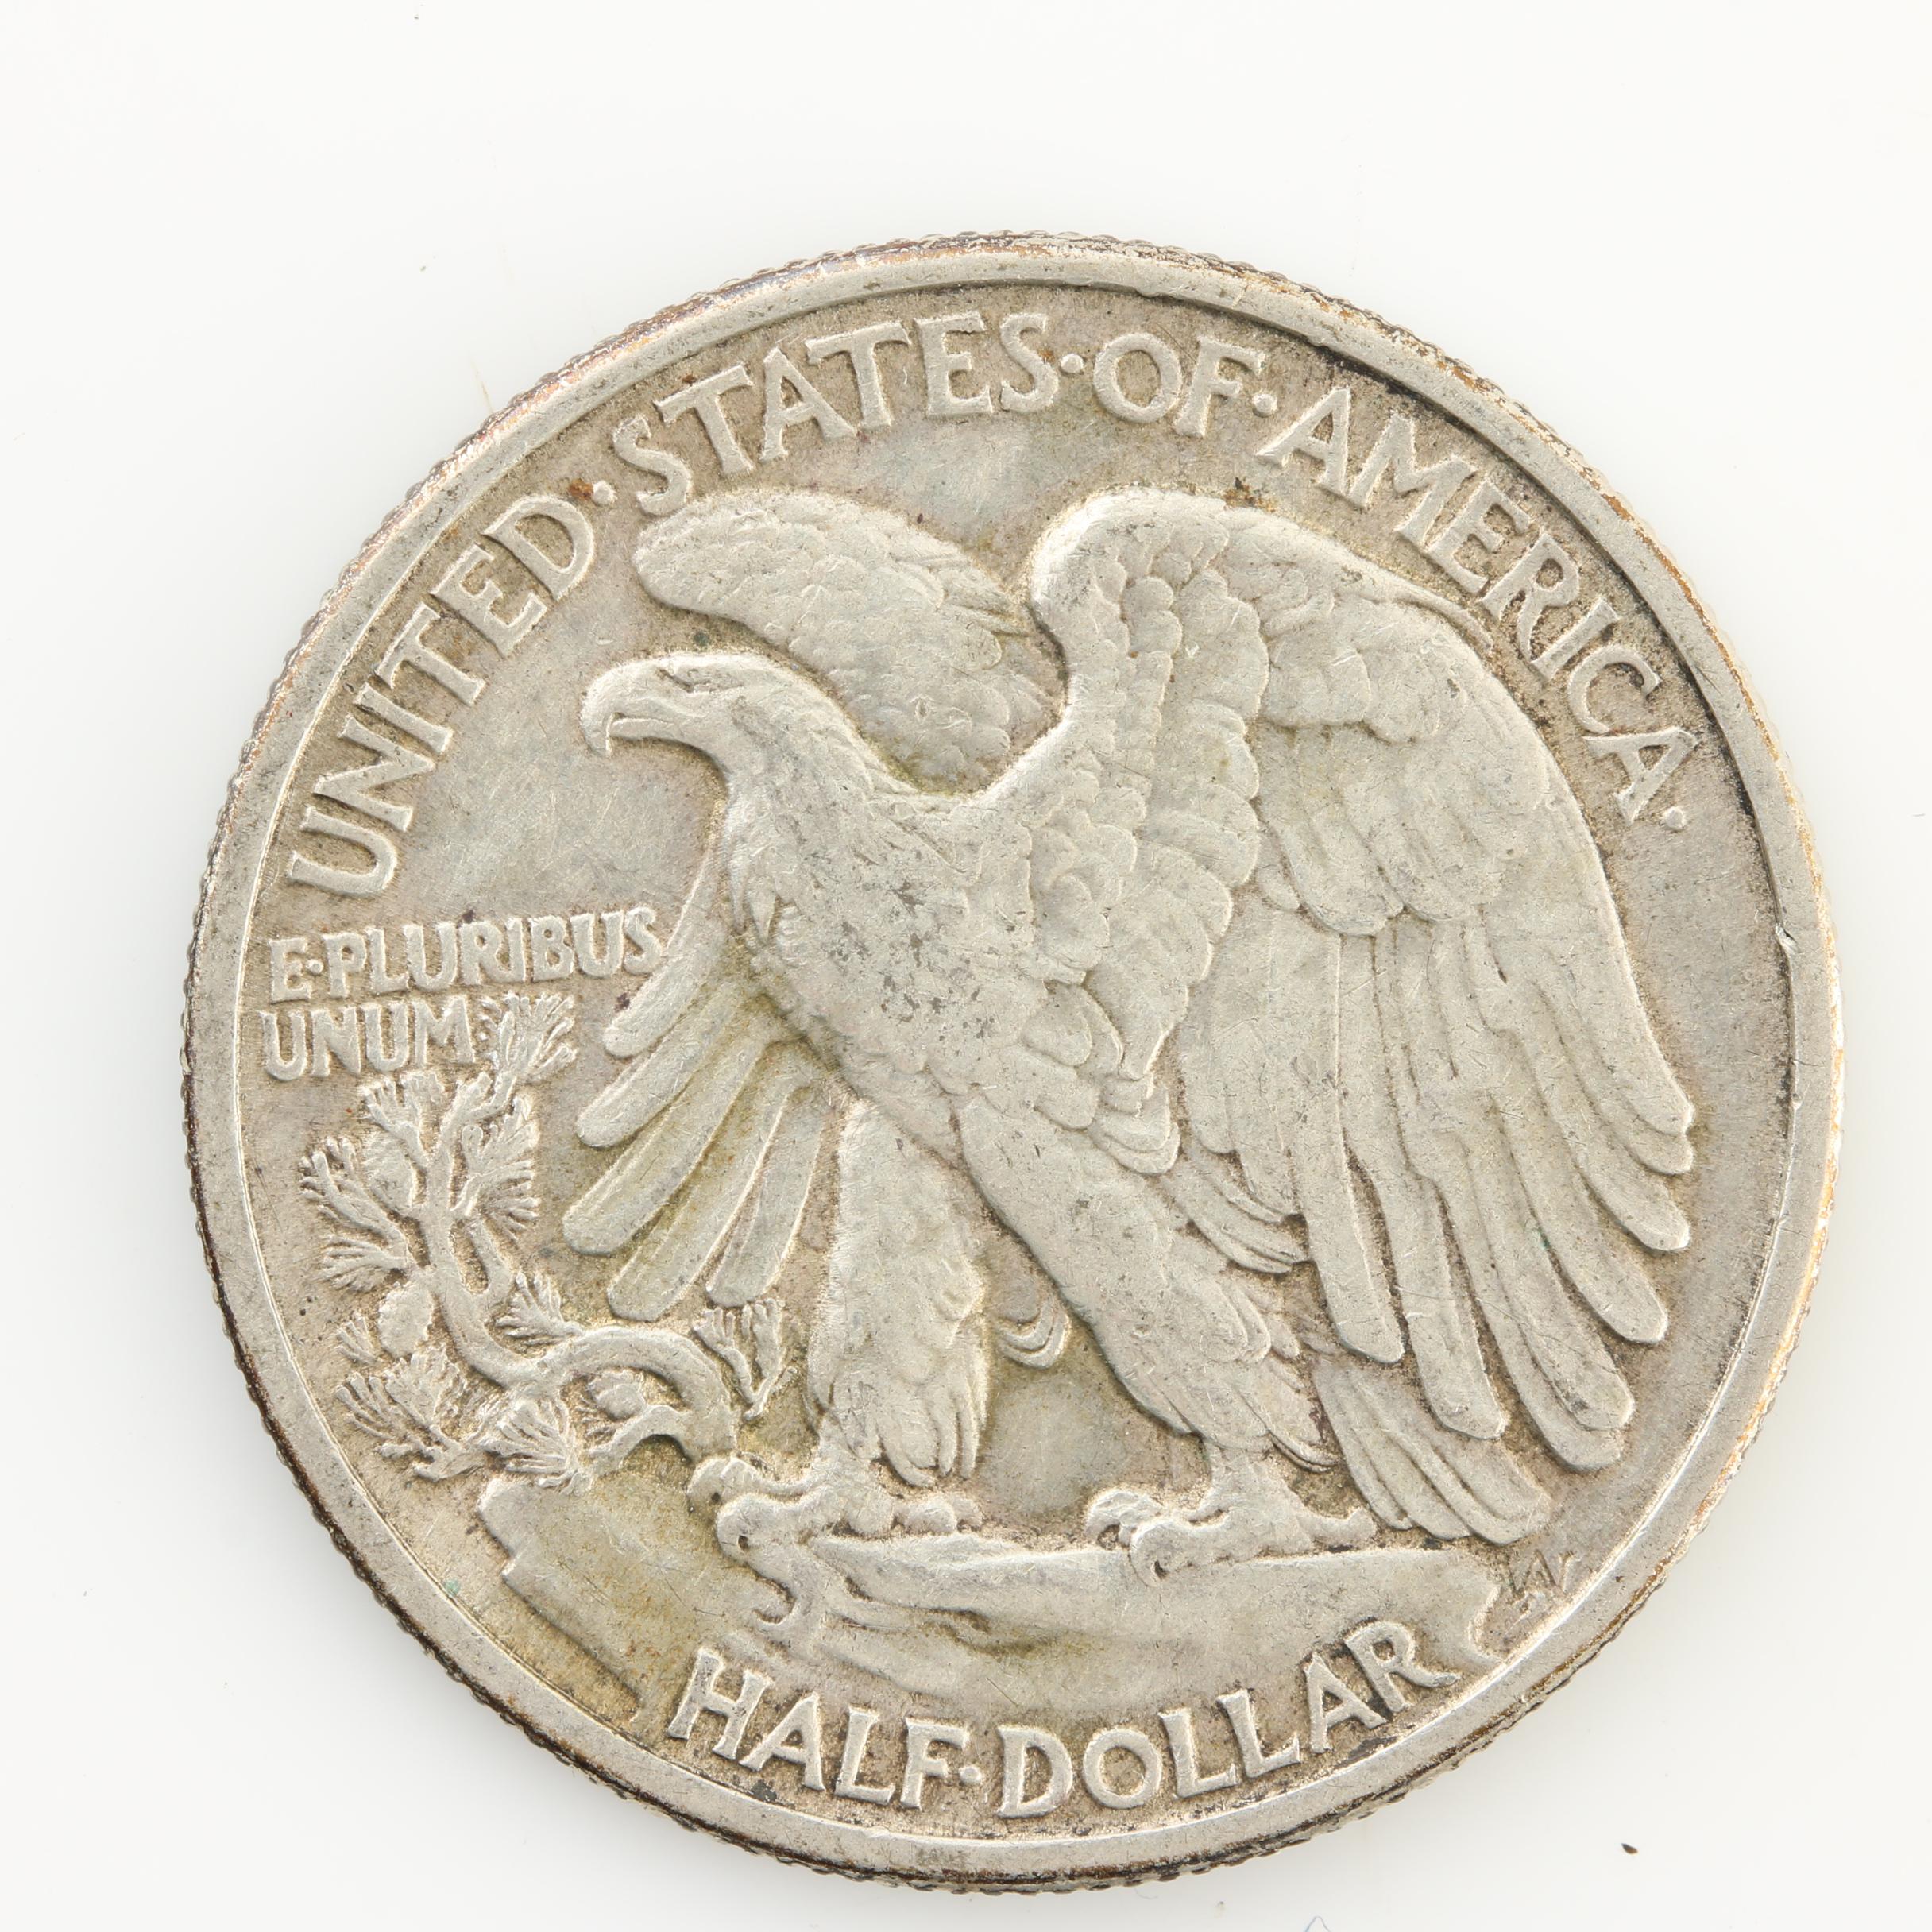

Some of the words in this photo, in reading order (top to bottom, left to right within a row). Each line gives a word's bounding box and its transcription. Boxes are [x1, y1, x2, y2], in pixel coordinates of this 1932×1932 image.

[287, 493, 595, 897] UNITED
[612, 311, 1059, 517] STATES
[259, 994, 475, 1081] UNUM
[667, 1647, 970, 1810] HALF
[995, 1616, 1460, 1820] DOLLAR
